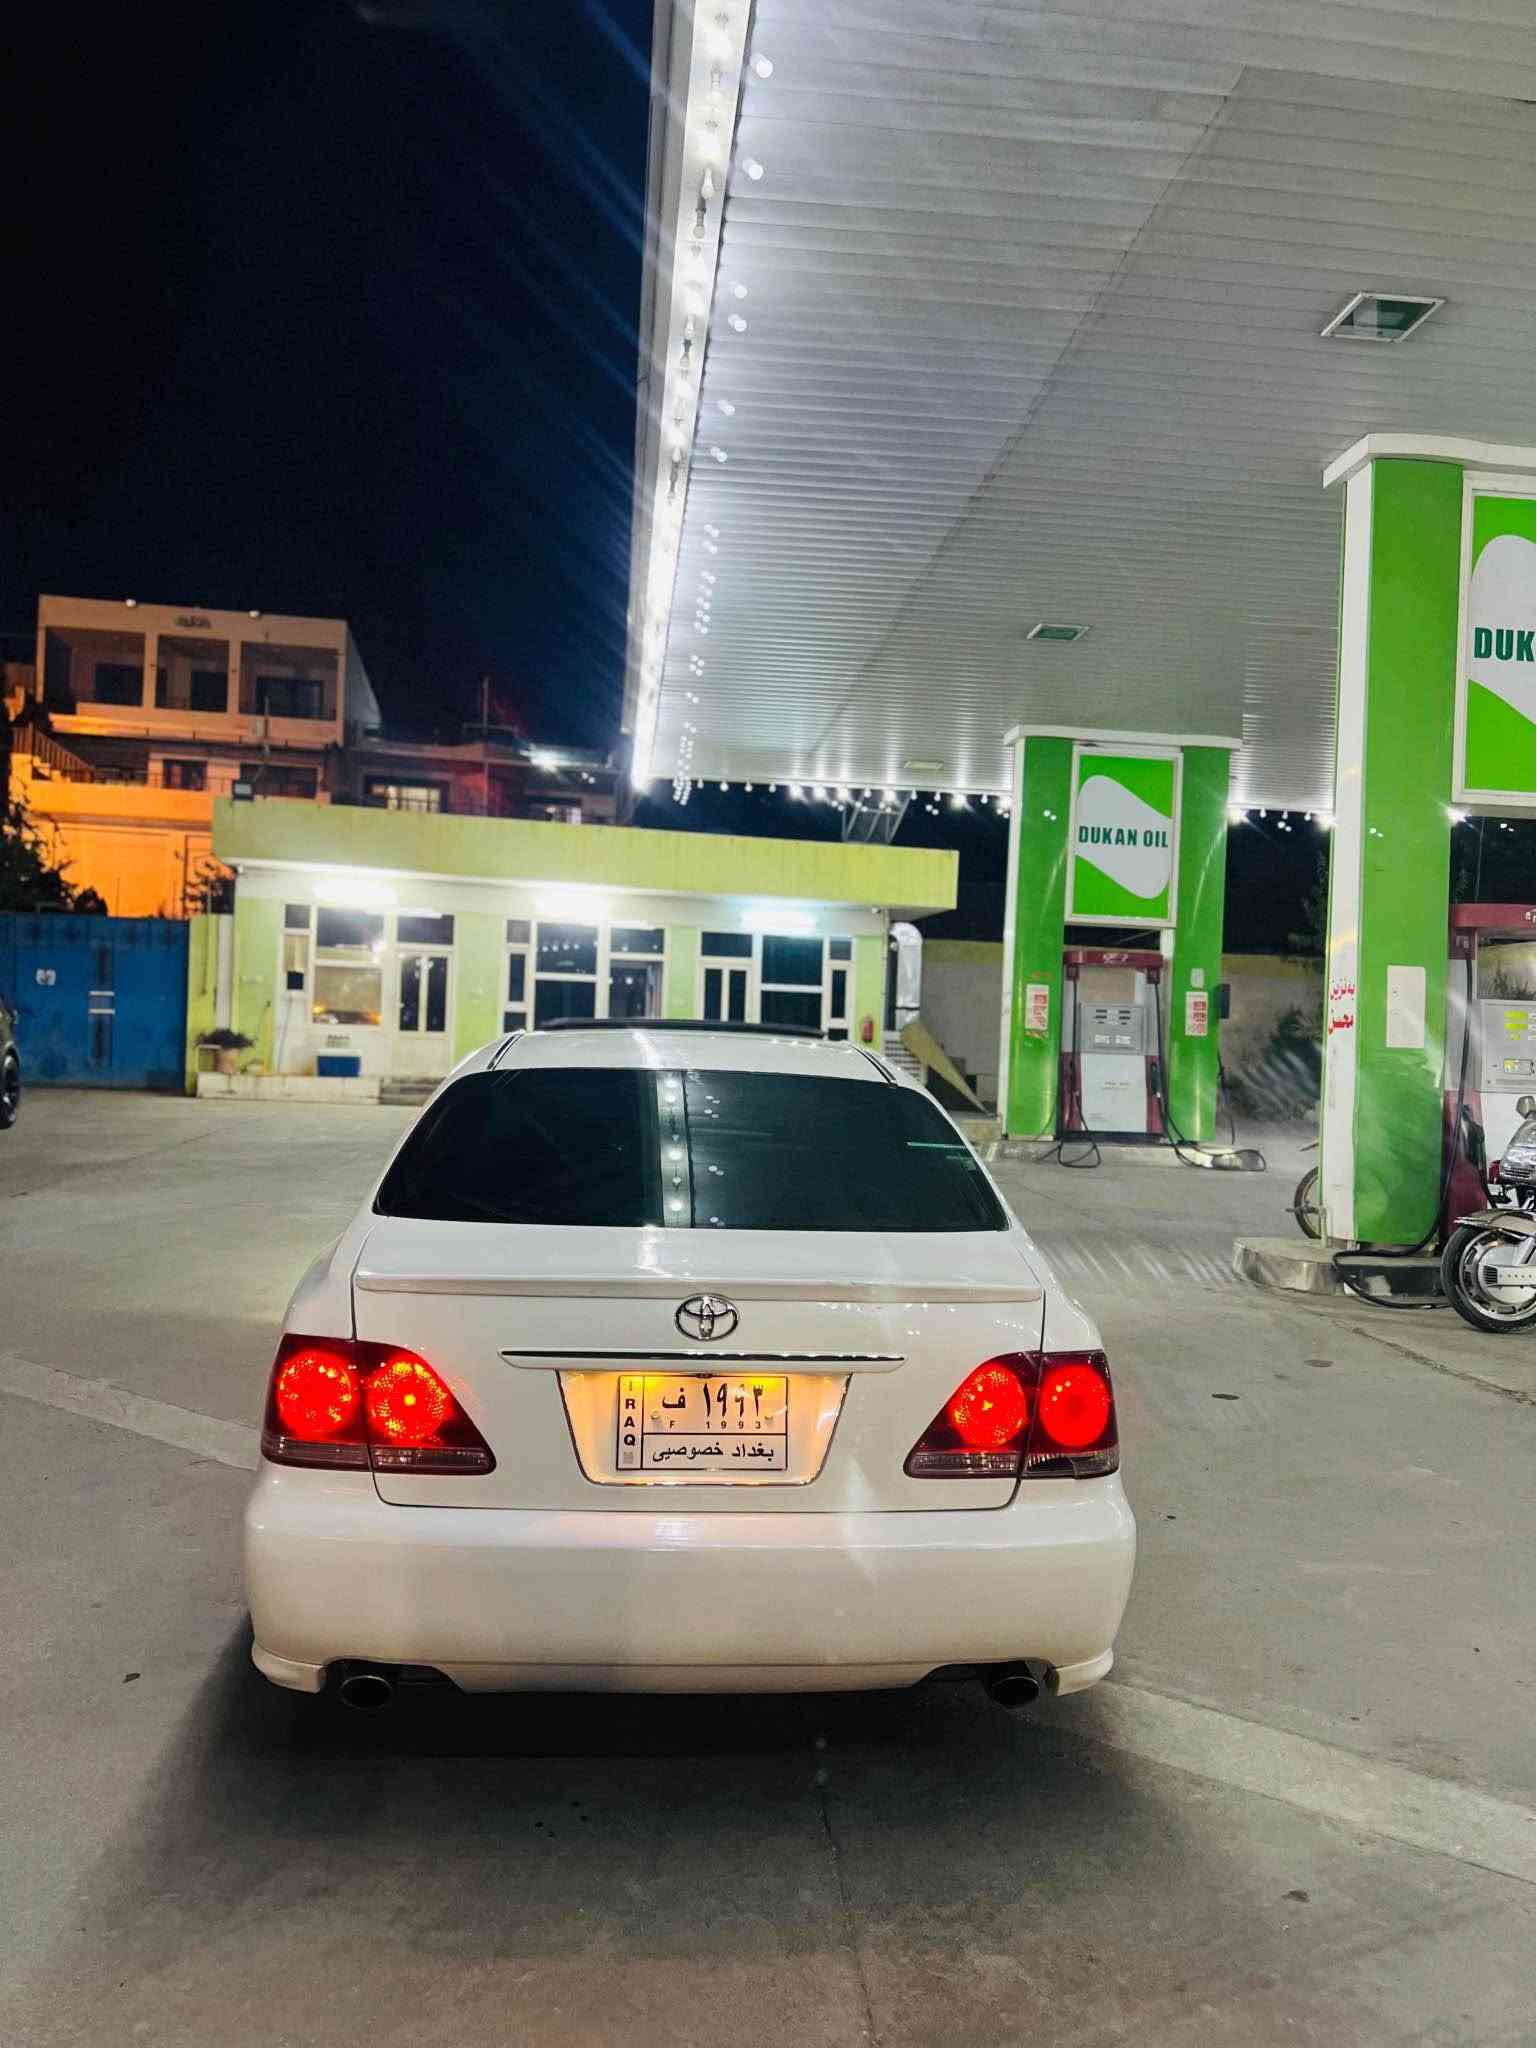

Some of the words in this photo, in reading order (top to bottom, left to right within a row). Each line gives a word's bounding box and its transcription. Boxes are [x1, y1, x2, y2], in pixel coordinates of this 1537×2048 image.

[1474, 626, 1535, 662] DUK
[1078, 825, 1137, 846] DUKAN
[1143, 829, 1169, 848] OIL
[731, 1442, 774, 1462] بغداد
